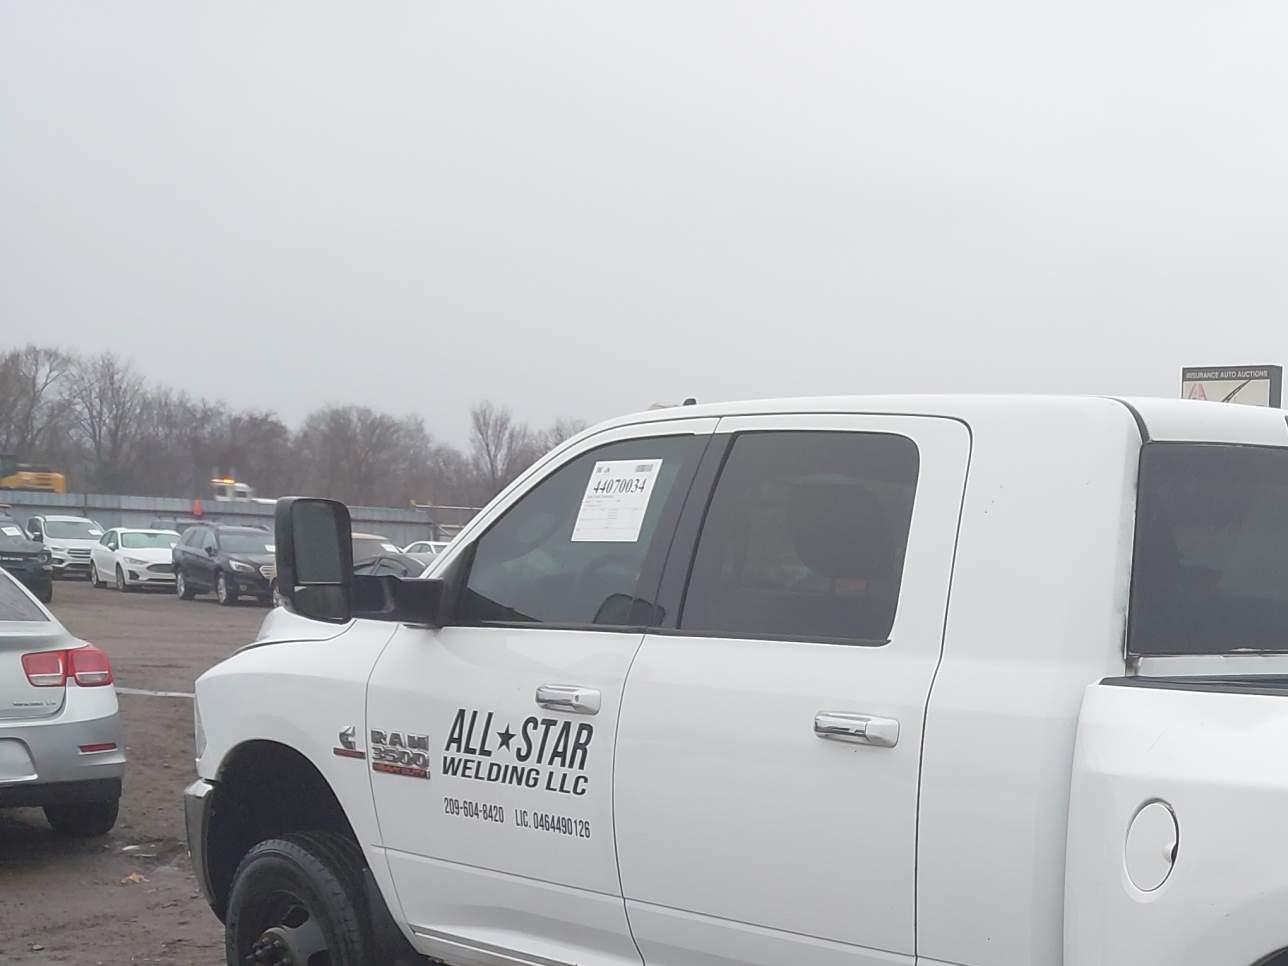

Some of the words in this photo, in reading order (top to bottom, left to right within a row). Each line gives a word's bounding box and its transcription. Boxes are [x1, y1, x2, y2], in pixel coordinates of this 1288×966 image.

[1220, 370, 1237, 378] AUTO
[1237, 369, 1268, 378] AUCTIONS
[593, 478, 647, 494] 44070034
[371, 729, 430, 751] RAM
[444, 708, 494, 757] ALL
[515, 716, 594, 770] STAR
[371, 746, 430, 768] 3500
[441, 755, 540, 788] WELDING
[545, 771, 589, 796] LLC
[444, 797, 504, 823] 209-604-8420
[515, 809, 531, 828] LIC.
[533, 812, 591, 838] 0464490126
